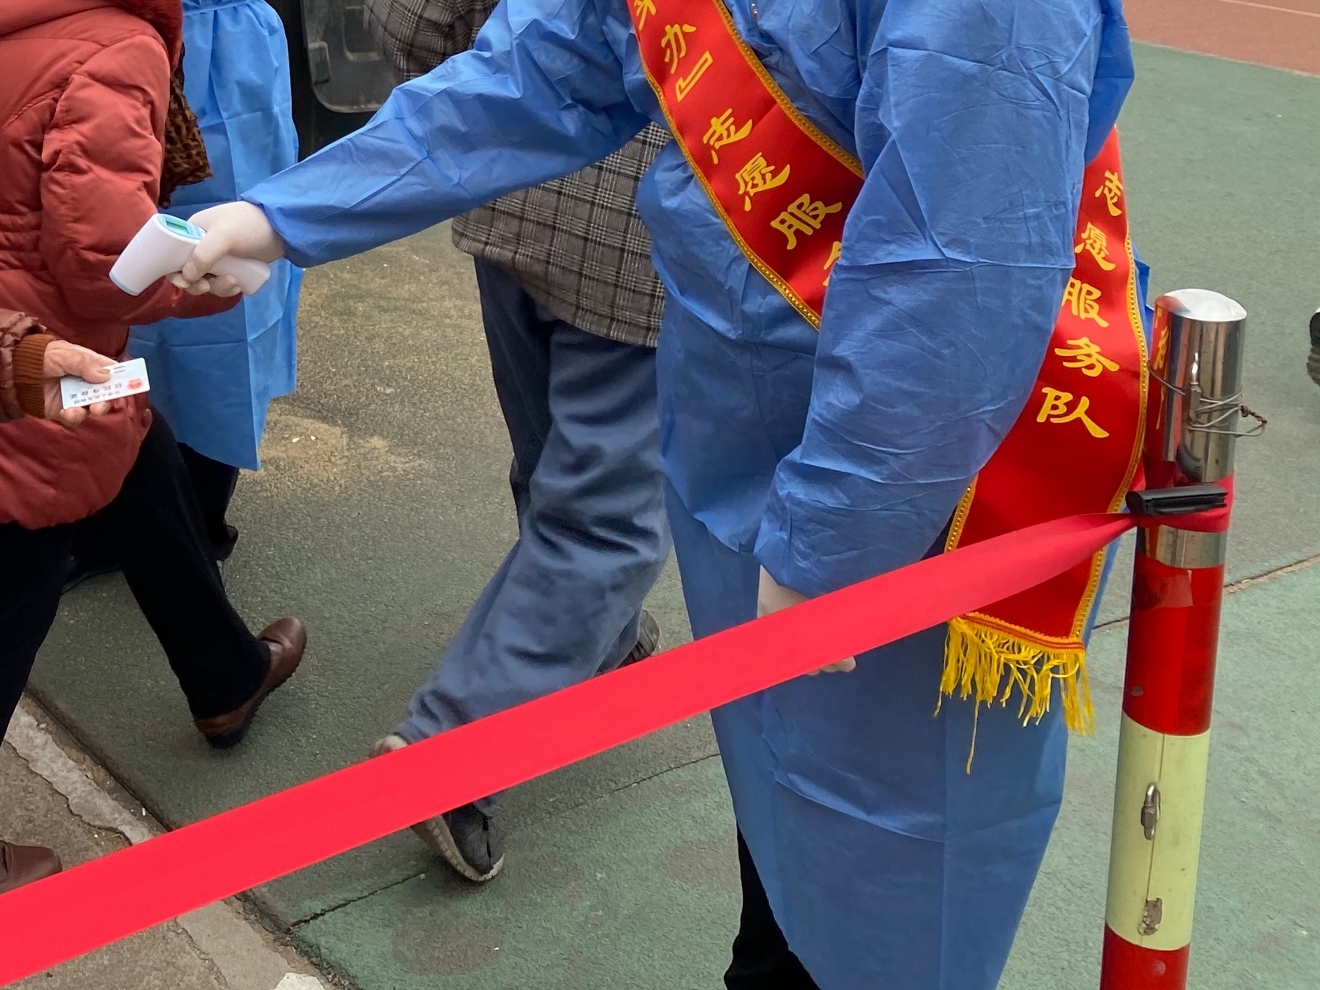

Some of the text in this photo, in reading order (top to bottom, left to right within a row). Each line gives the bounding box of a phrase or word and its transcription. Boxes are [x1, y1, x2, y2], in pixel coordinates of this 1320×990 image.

[1036, 170, 1124, 438] 志愿服务队
